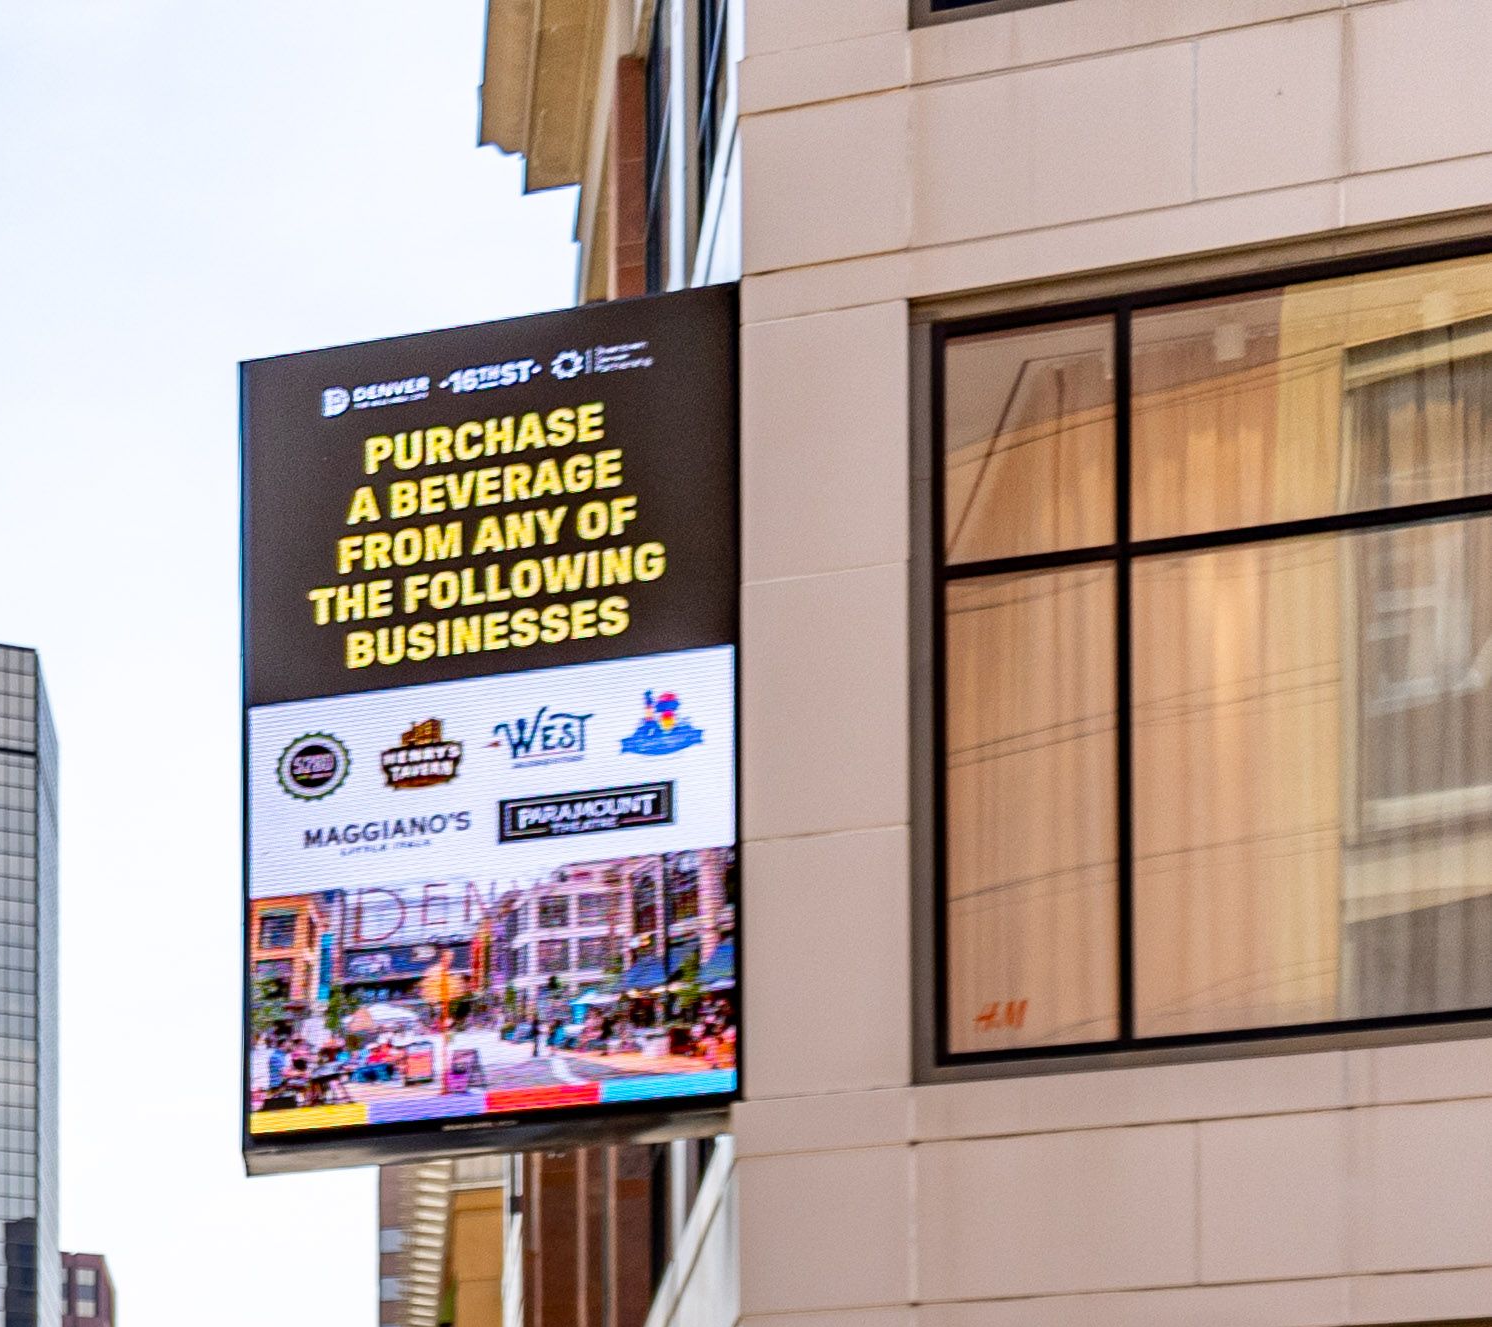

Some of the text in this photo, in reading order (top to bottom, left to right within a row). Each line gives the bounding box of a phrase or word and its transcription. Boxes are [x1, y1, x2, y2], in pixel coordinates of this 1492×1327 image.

[365, 402, 605, 475] PURCHASE
[346, 449, 623, 526] A BEVERAGE
[337, 496, 638, 574] FROM ANY OF
[307, 542, 667, 625] THE FOLLOWING
[345, 595, 630, 669] BUSINESSES
[492, 704, 597, 760] WEST
[304, 811, 471, 848] MAGGIANO'S
[516, 792, 658, 830] PARAMOUNT
